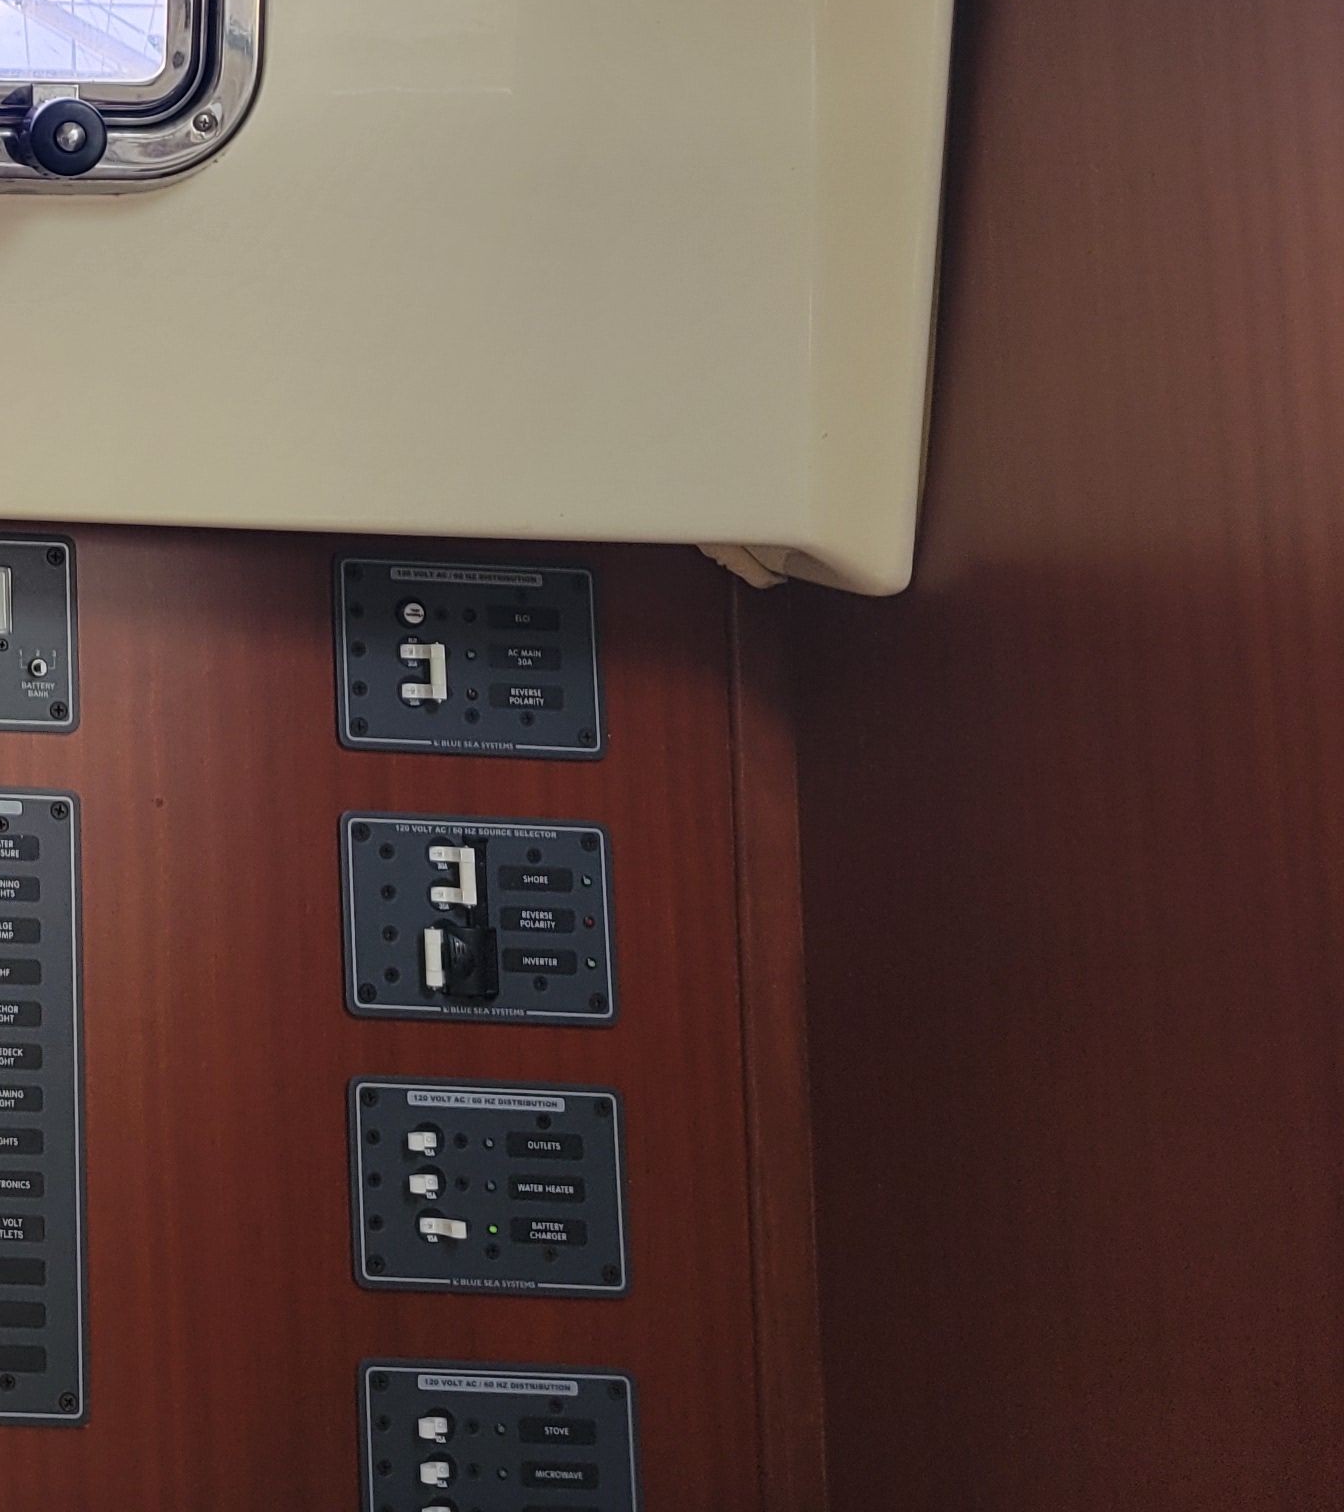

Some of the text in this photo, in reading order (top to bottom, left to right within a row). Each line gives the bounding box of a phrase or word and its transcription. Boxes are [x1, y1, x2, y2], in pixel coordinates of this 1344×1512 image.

[508, 648, 542, 658] AC MAIN
[22, 682, 56, 690] BATTERY
[28, 690, 49, 698] BANK
[510, 688, 542, 696] REVERSE
[509, 696, 544, 706] POLARITY
[441, 740, 461, 748] BLUE
[396, 824, 410, 832] 120
[412, 825, 434, 834] VOLT
[435, 826, 447, 834] AC
[452, 827, 463, 835] 60
[465, 827, 477, 836] HZ
[478, 828, 512, 837] SOURCE
[514, 829, 557, 839] SELECTOR
[522, 874, 548, 885] SHORE
[521, 910, 553, 920] REVERSE
[520, 919, 556, 930] POLARITY
[522, 957, 558, 967] INVERTER
[451, 1006, 525, 1016] BLUE SEA SYSTEMS
[414, 1095, 428, 1103] 120
[430, 1095, 451, 1104] VOLT
[454, 1096, 465, 1104] AC
[484, 1098, 496, 1106] HZ
[498, 1098, 558, 1108] DISTRIBUTION
[527, 1141, 561, 1151] OUTLETS
[517, 1183, 574, 1194] WATER HEATER
[2, 1218, 23, 1228] VOLT
[531, 1222, 564, 1232] BATTERY
[529, 1231, 567, 1241] CHARGER
[460, 1278, 535, 1289] BLUE SEA SYSTEMS
[424, 1378, 439, 1386] 120
[441, 1379, 463, 1387] VOLT
[466, 1380, 477, 1388] AC
[496, 1381, 508, 1389] HZ
[510, 1382, 571, 1392] DISTRIBUTION
[544, 1426, 569, 1436] STOVE
[535, 1470, 583, 1481] MICROWAVE
